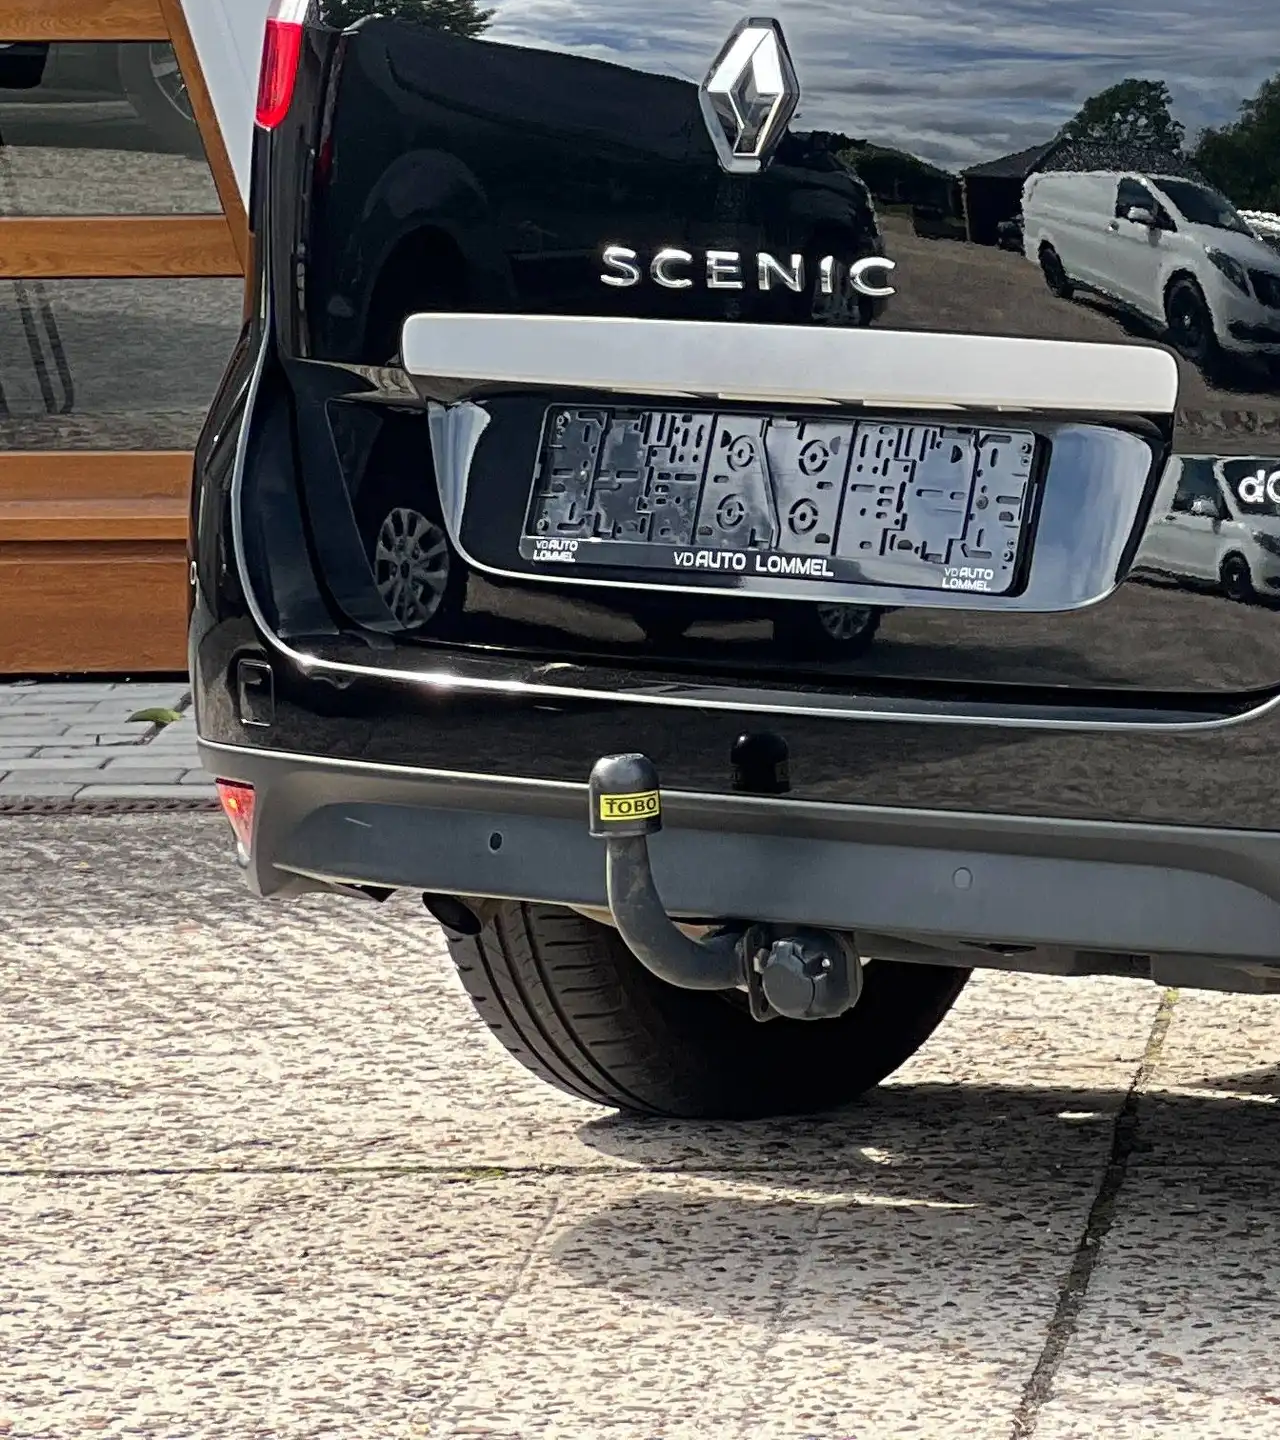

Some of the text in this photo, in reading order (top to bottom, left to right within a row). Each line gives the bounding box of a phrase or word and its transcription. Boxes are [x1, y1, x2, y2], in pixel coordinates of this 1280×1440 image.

[600, 245, 897, 296] SCENIC
[755, 555, 834, 577] LOMMEL
[942, 578, 992, 591] LOMMEL
[606, 798, 656, 813] TOBO
